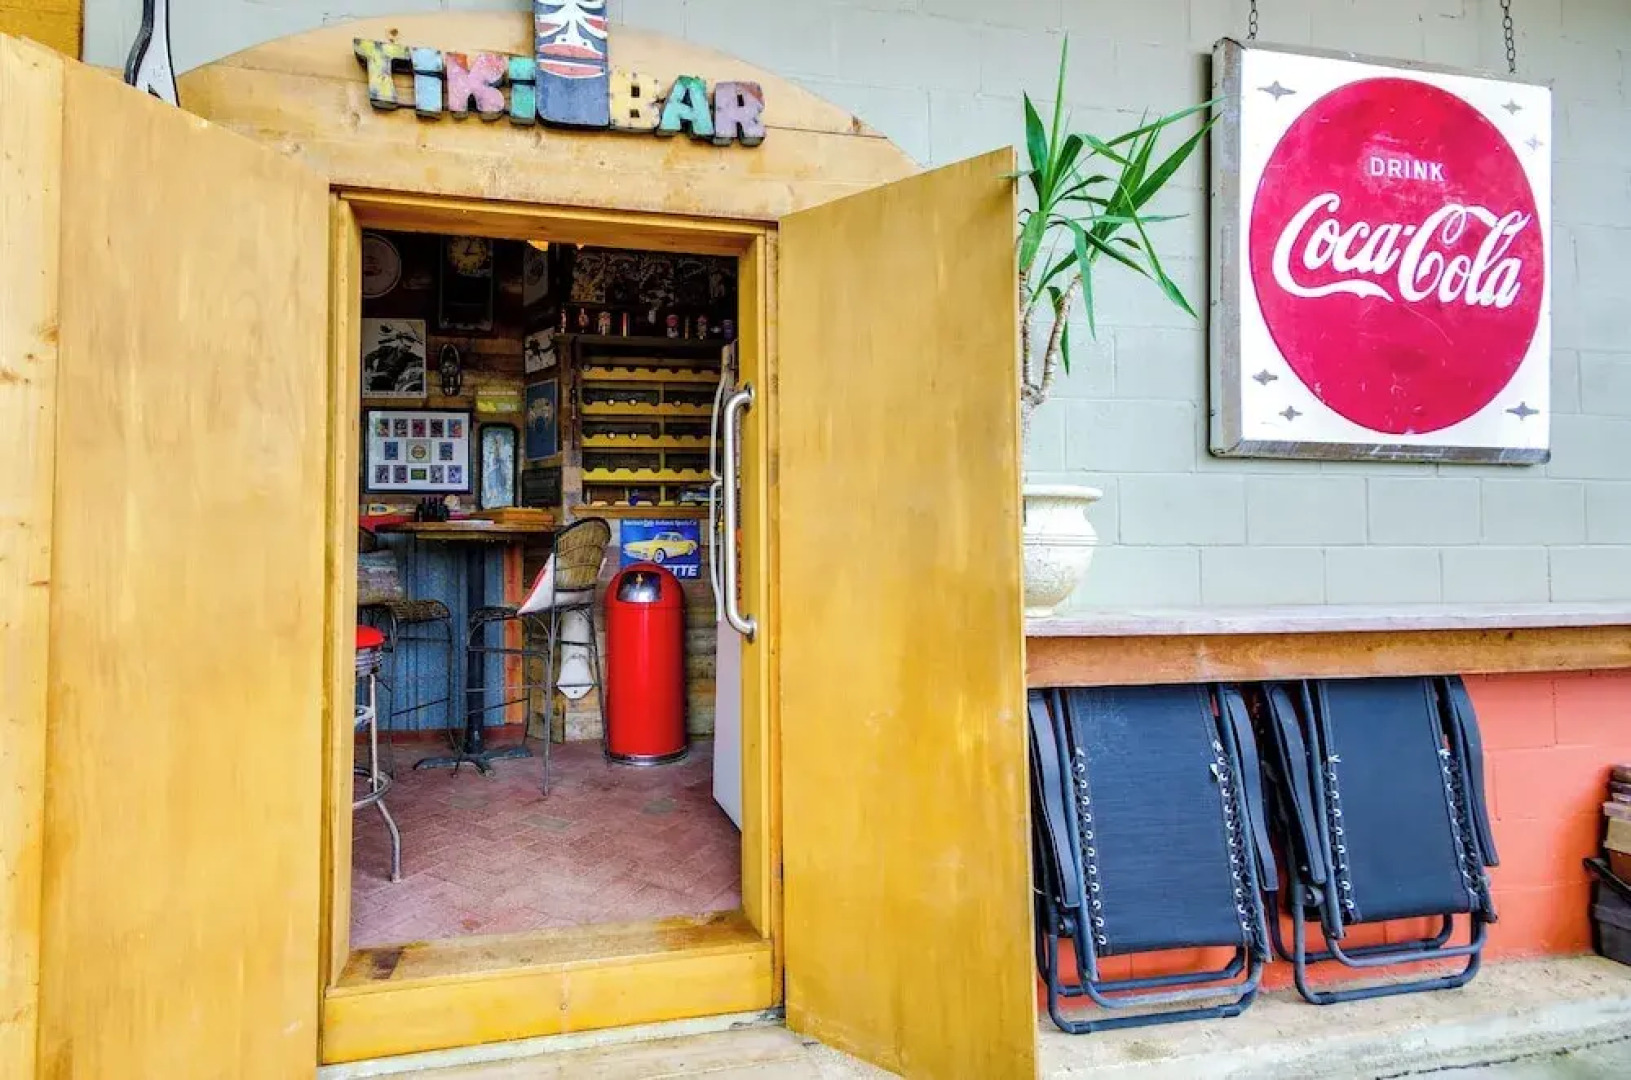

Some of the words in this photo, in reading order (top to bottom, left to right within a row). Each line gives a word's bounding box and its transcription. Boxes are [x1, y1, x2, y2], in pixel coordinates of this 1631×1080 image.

[608, 70, 766, 147] BAR
[1369, 155, 1446, 182] DRINK
[1272, 191, 1531, 309] Coca-Cola
